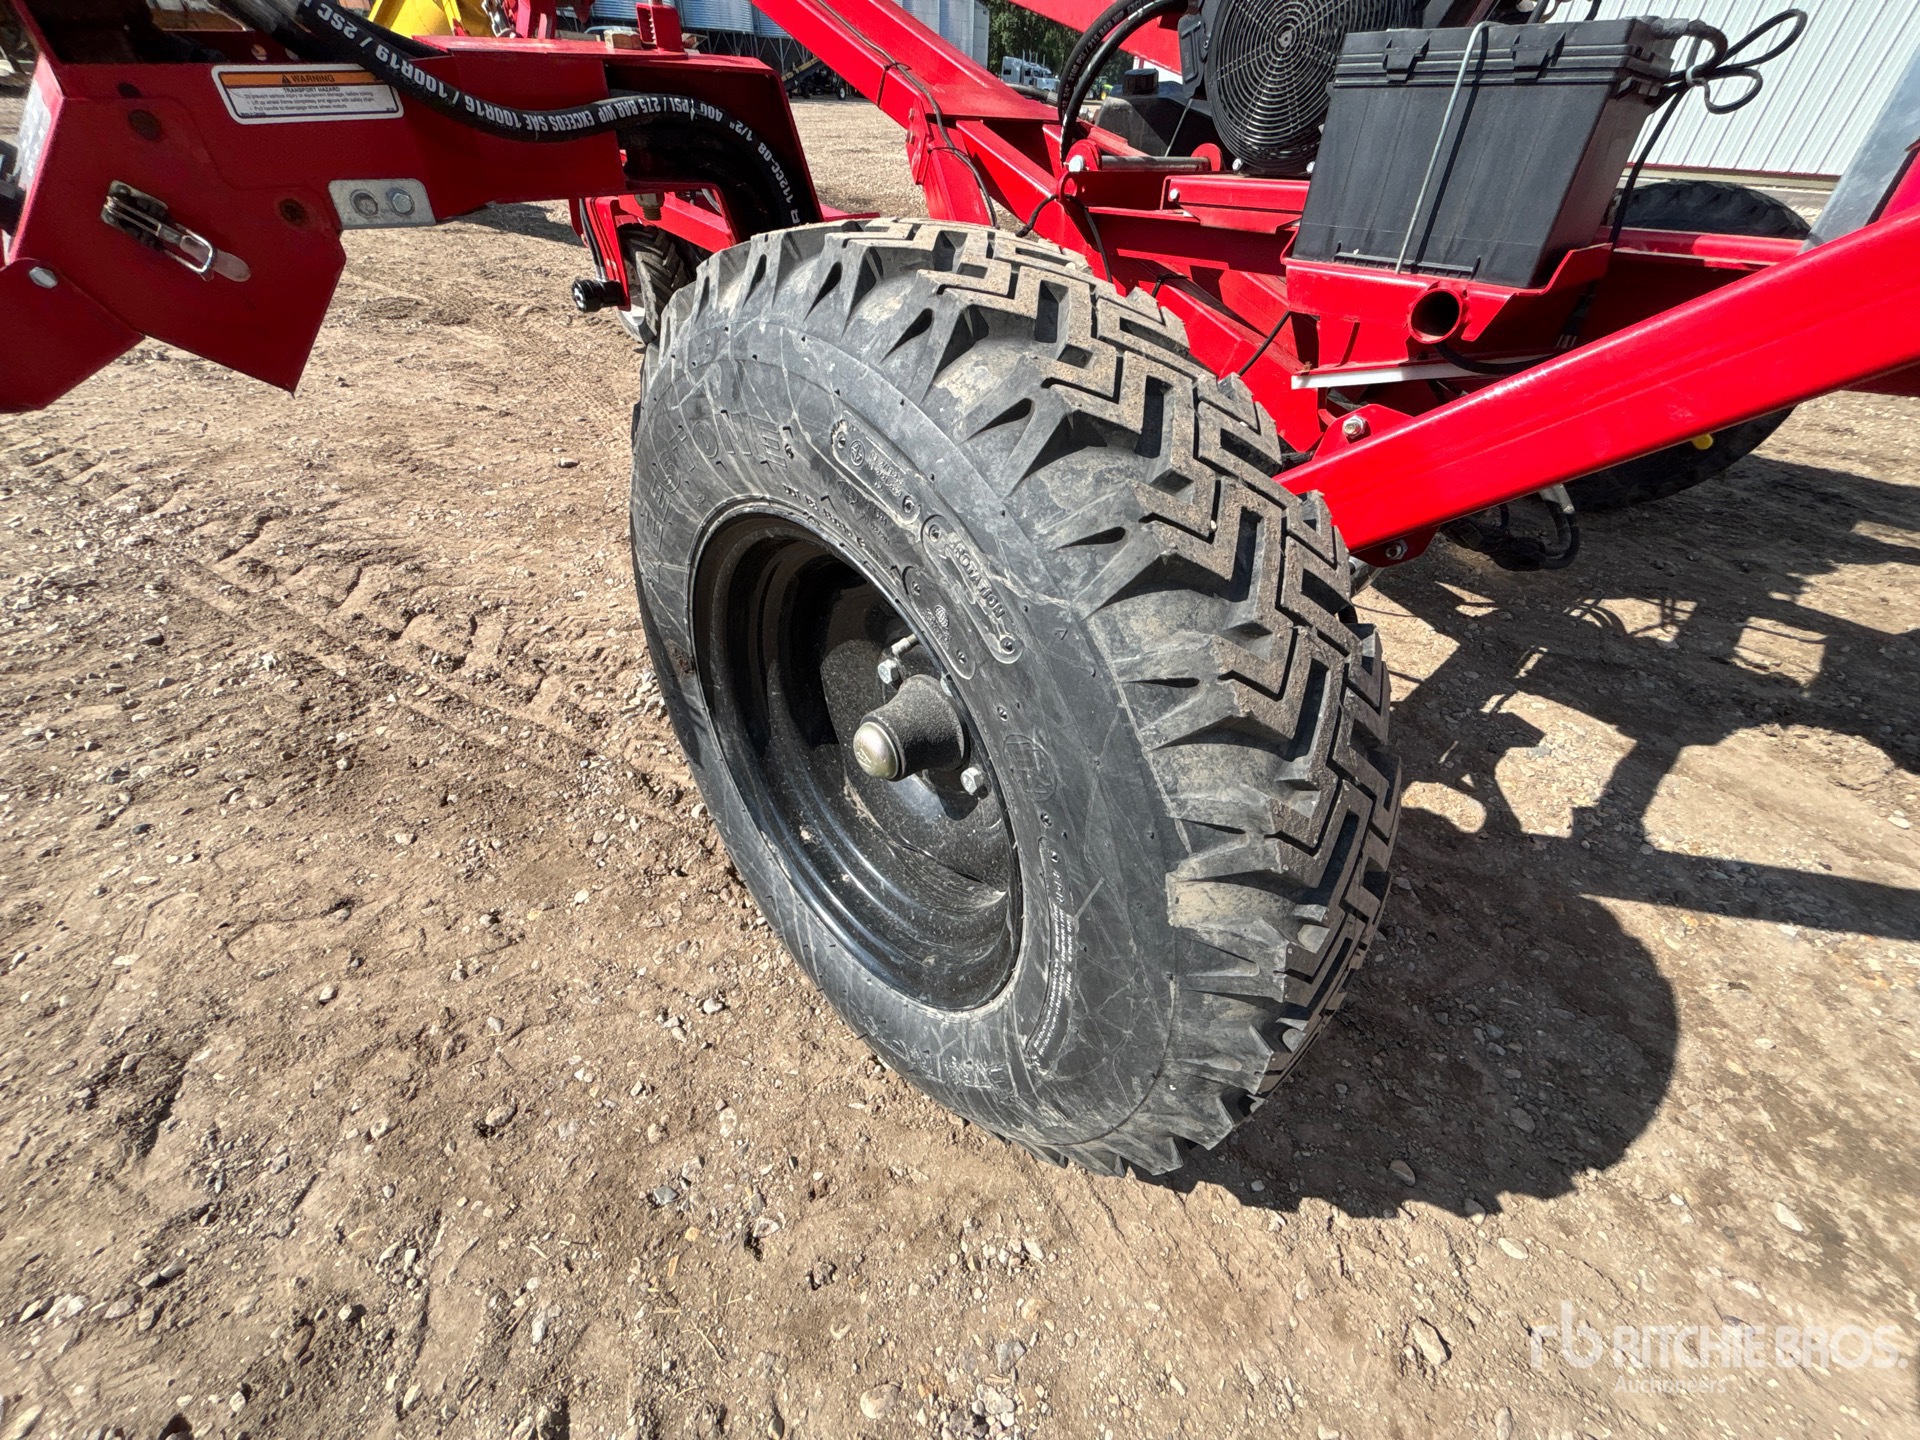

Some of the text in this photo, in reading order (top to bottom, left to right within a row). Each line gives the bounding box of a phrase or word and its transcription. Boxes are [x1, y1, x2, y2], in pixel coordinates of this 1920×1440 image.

[316, 3, 358, 40] 2SC
[291, 74, 335, 84] WARNING
[375, 44, 448, 98] 100R19
[465, 95, 522, 129] 100R16
[598, 102, 618, 123] WP
[613, 99, 639, 119] BAR
[640, 97, 661, 114] 275
[670, 97, 690, 112] PSI
[523, 112, 549, 132] SAE
[548, 110, 596, 132] EXCEEDS
[757, 142, 794, 204] 112CC-08
[953, 540, 1006, 619] ROTATION
